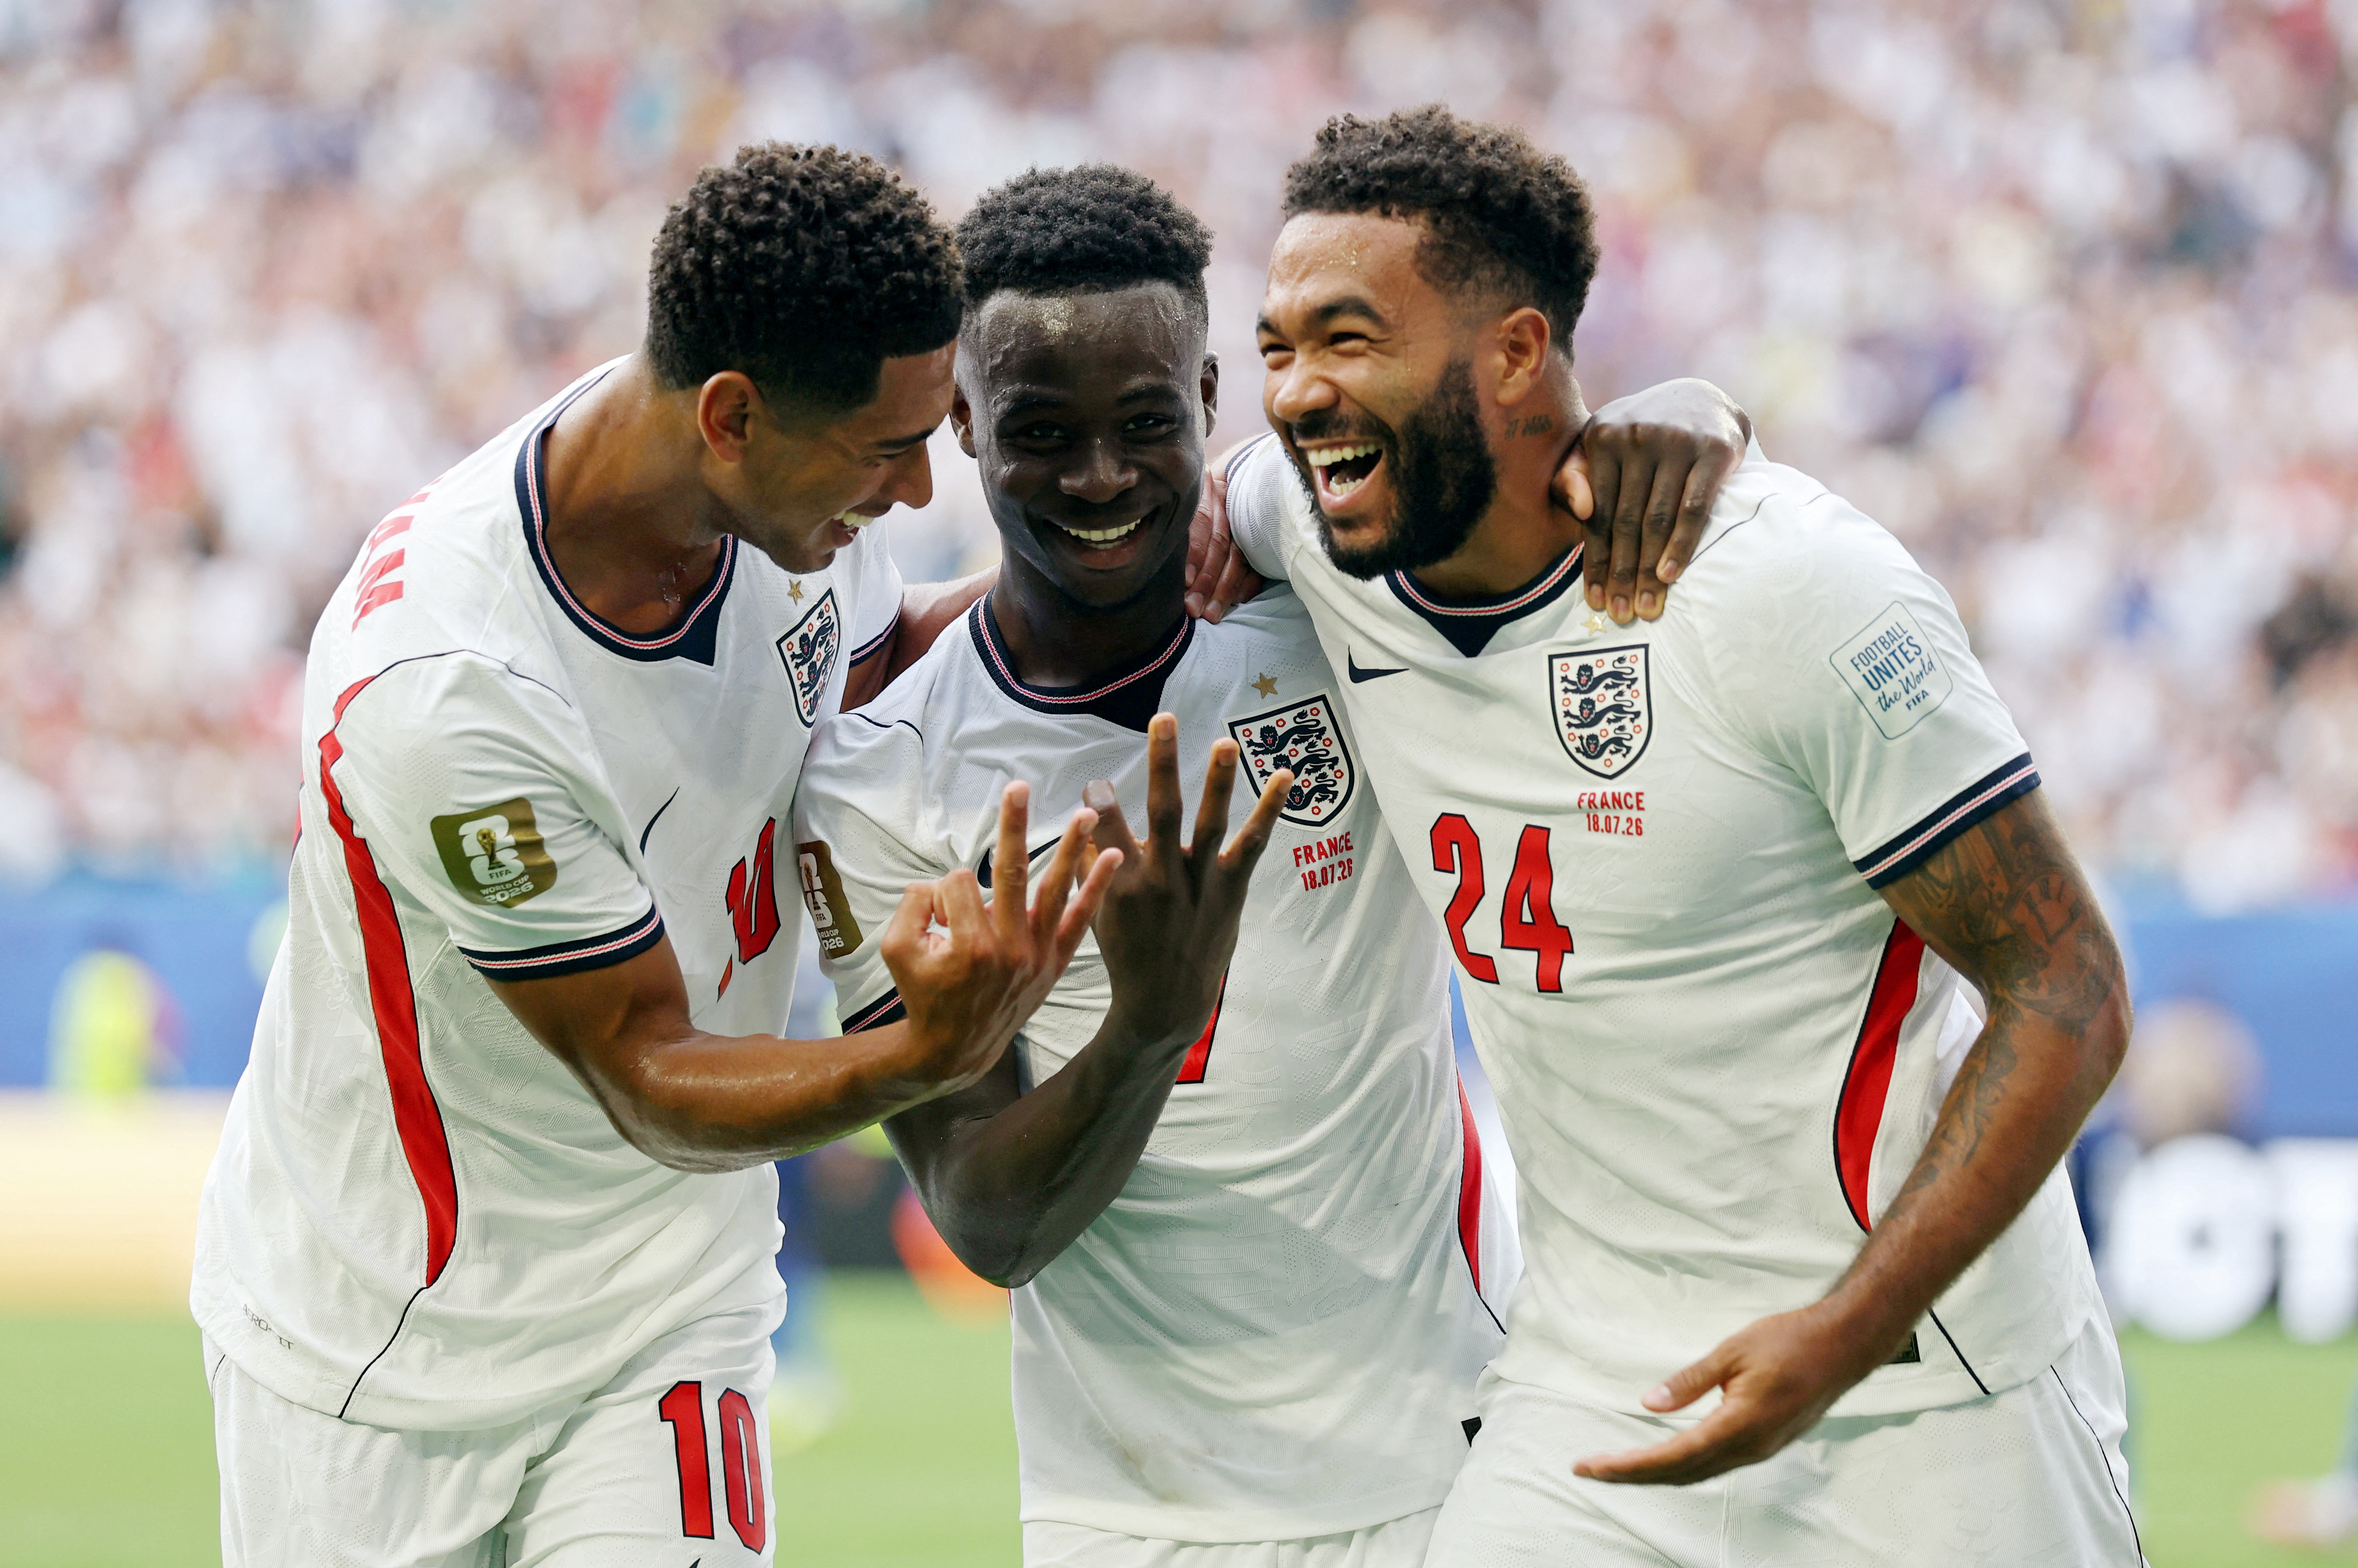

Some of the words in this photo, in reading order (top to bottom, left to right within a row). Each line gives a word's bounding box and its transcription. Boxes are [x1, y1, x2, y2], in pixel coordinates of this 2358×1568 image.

[1850, 621, 1908, 673] FOOTBALL
[1862, 635, 1922, 691] UNITES
[1875, 691, 1902, 713] the
[1898, 652, 1936, 695] World
[1905, 690, 1929, 711] FIFA
[1577, 791, 1645, 811] FRANCE
[1586, 813, 1643, 836] 18.07.26
[1292, 831, 1353, 867] FRANCE
[480, 883, 512, 895] WORLD
[513, 874, 529, 887] CUP
[489, 869, 512, 879] FIFA
[1301, 857, 1353, 891] 18.07.26
[483, 881, 534, 904] 2026
[1430, 812, 1575, 993] 24
[815, 913, 827, 922] FIFA
[822, 936, 845, 951] 026
[829, 929, 839, 937] CUP
[658, 1380, 765, 1555] 10
